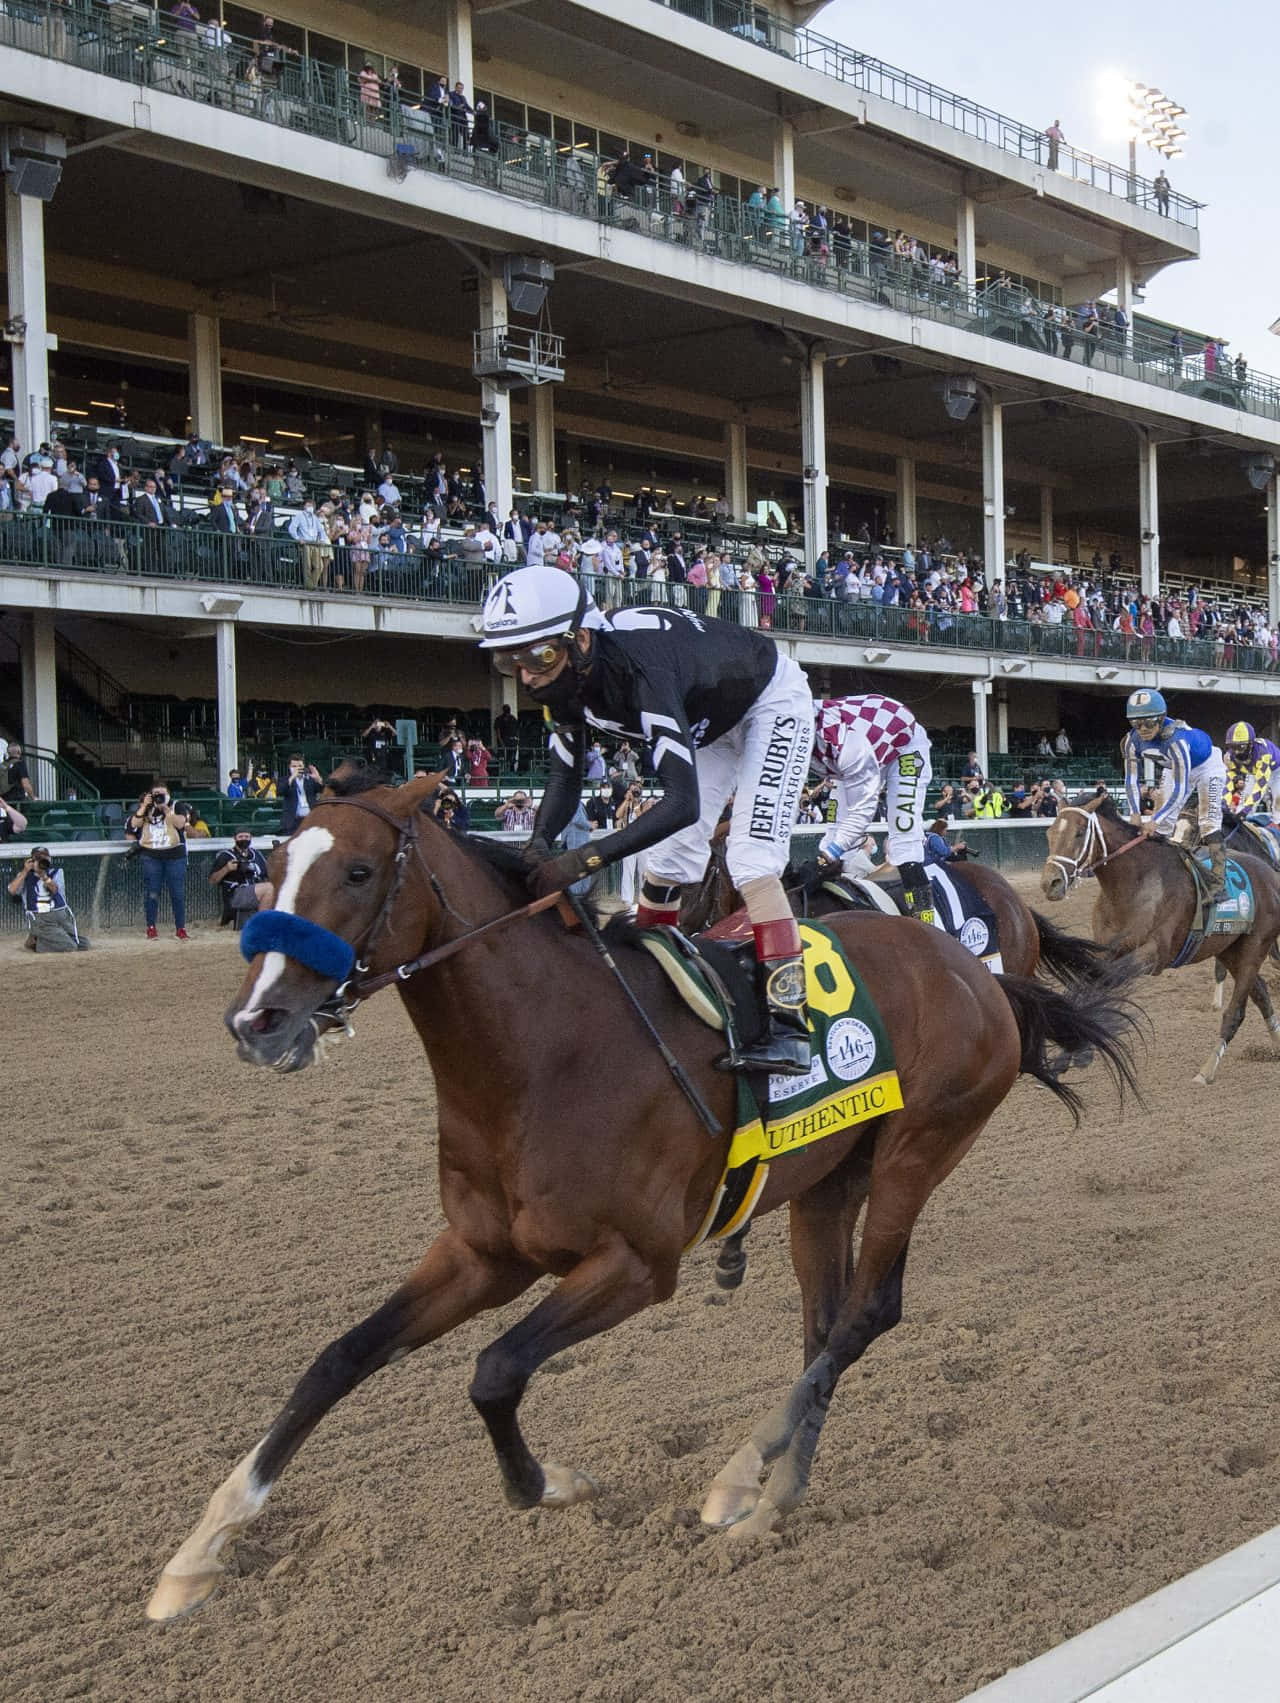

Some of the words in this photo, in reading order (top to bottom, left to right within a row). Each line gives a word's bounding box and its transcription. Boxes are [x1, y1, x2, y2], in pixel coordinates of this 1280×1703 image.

[758, 716, 797, 788] RUBY'S
[899, 751, 916, 777] 811
[779, 726, 811, 839] STEAKHOUSES
[896, 776, 919, 833] CALL
[748, 793, 776, 842] JEFF
[798, 924, 856, 1032] 8
[839, 1035, 864, 1061] 146
[773, 1074, 818, 1099] ESERVE
[767, 1086, 887, 1150] UTHENTIC
